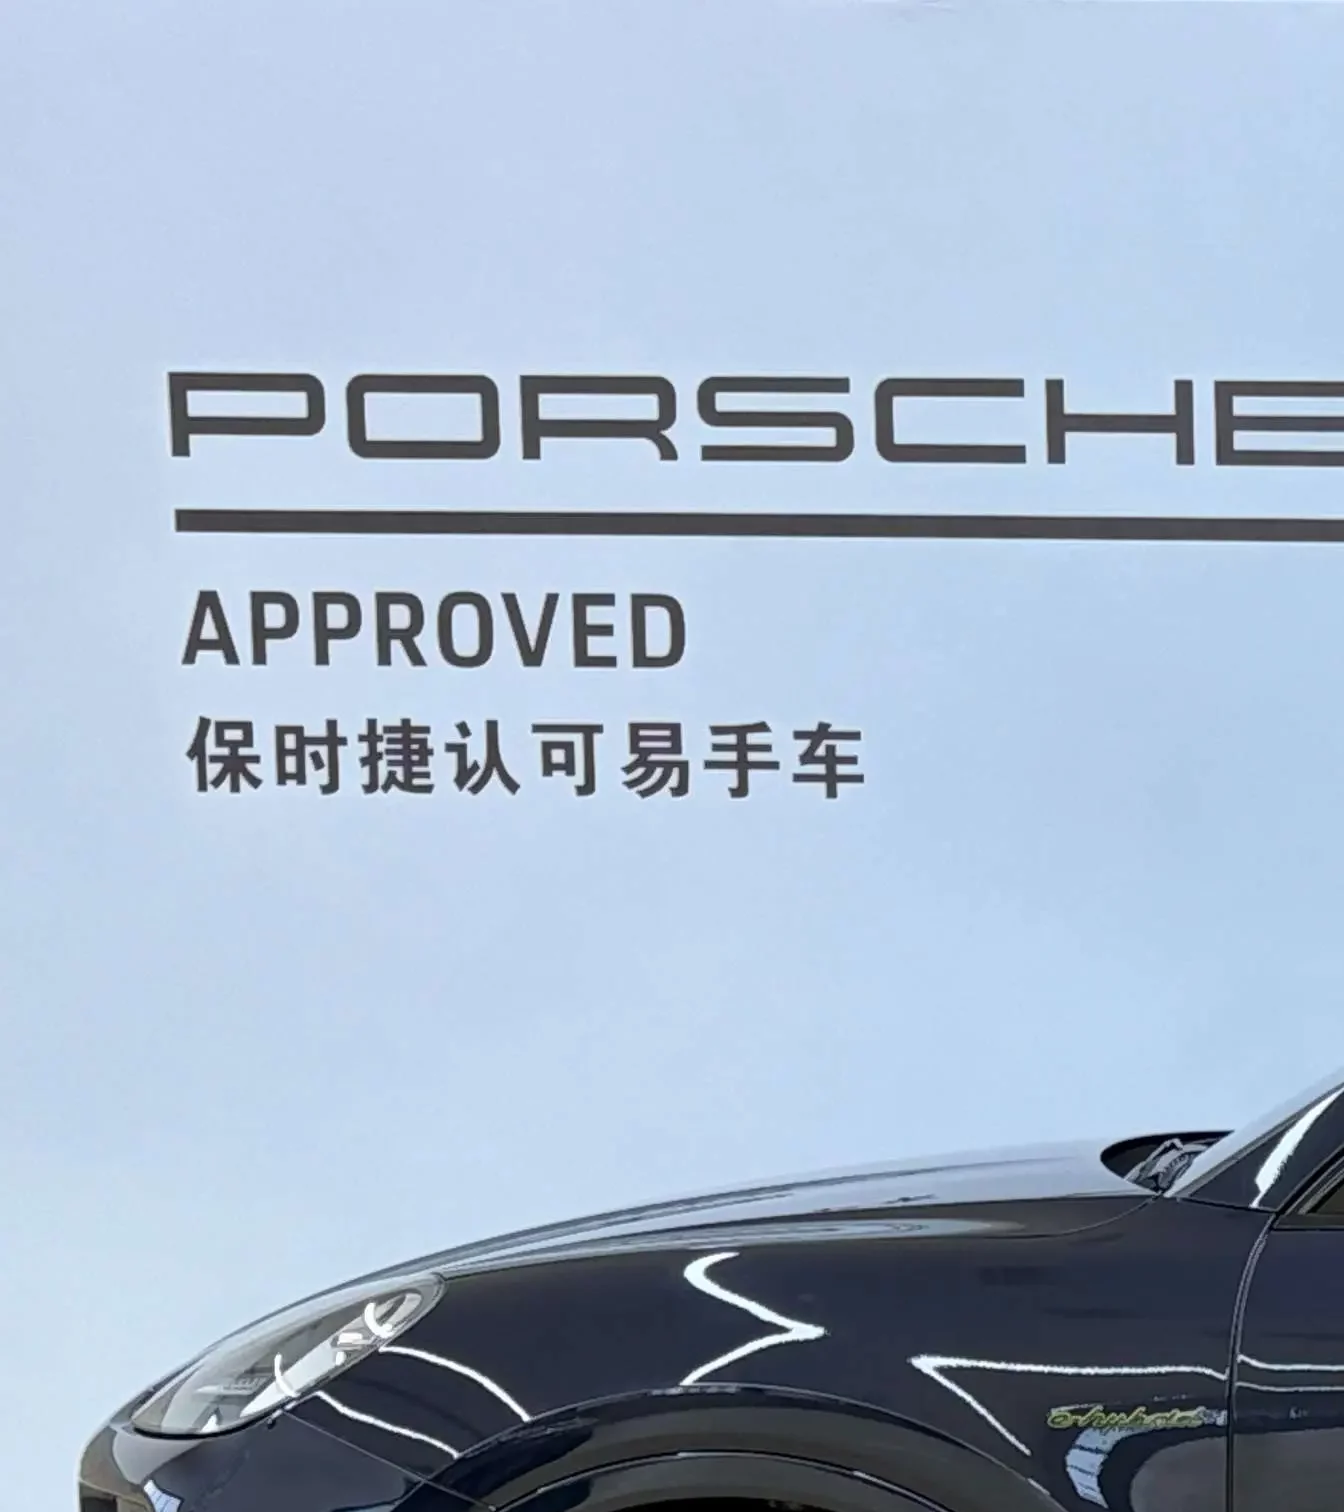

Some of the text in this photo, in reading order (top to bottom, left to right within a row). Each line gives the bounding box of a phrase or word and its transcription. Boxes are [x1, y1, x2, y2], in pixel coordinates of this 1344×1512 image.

[183, 591, 685, 667] APPROVED
[187, 717, 864, 798] 保时捷认可易手车
